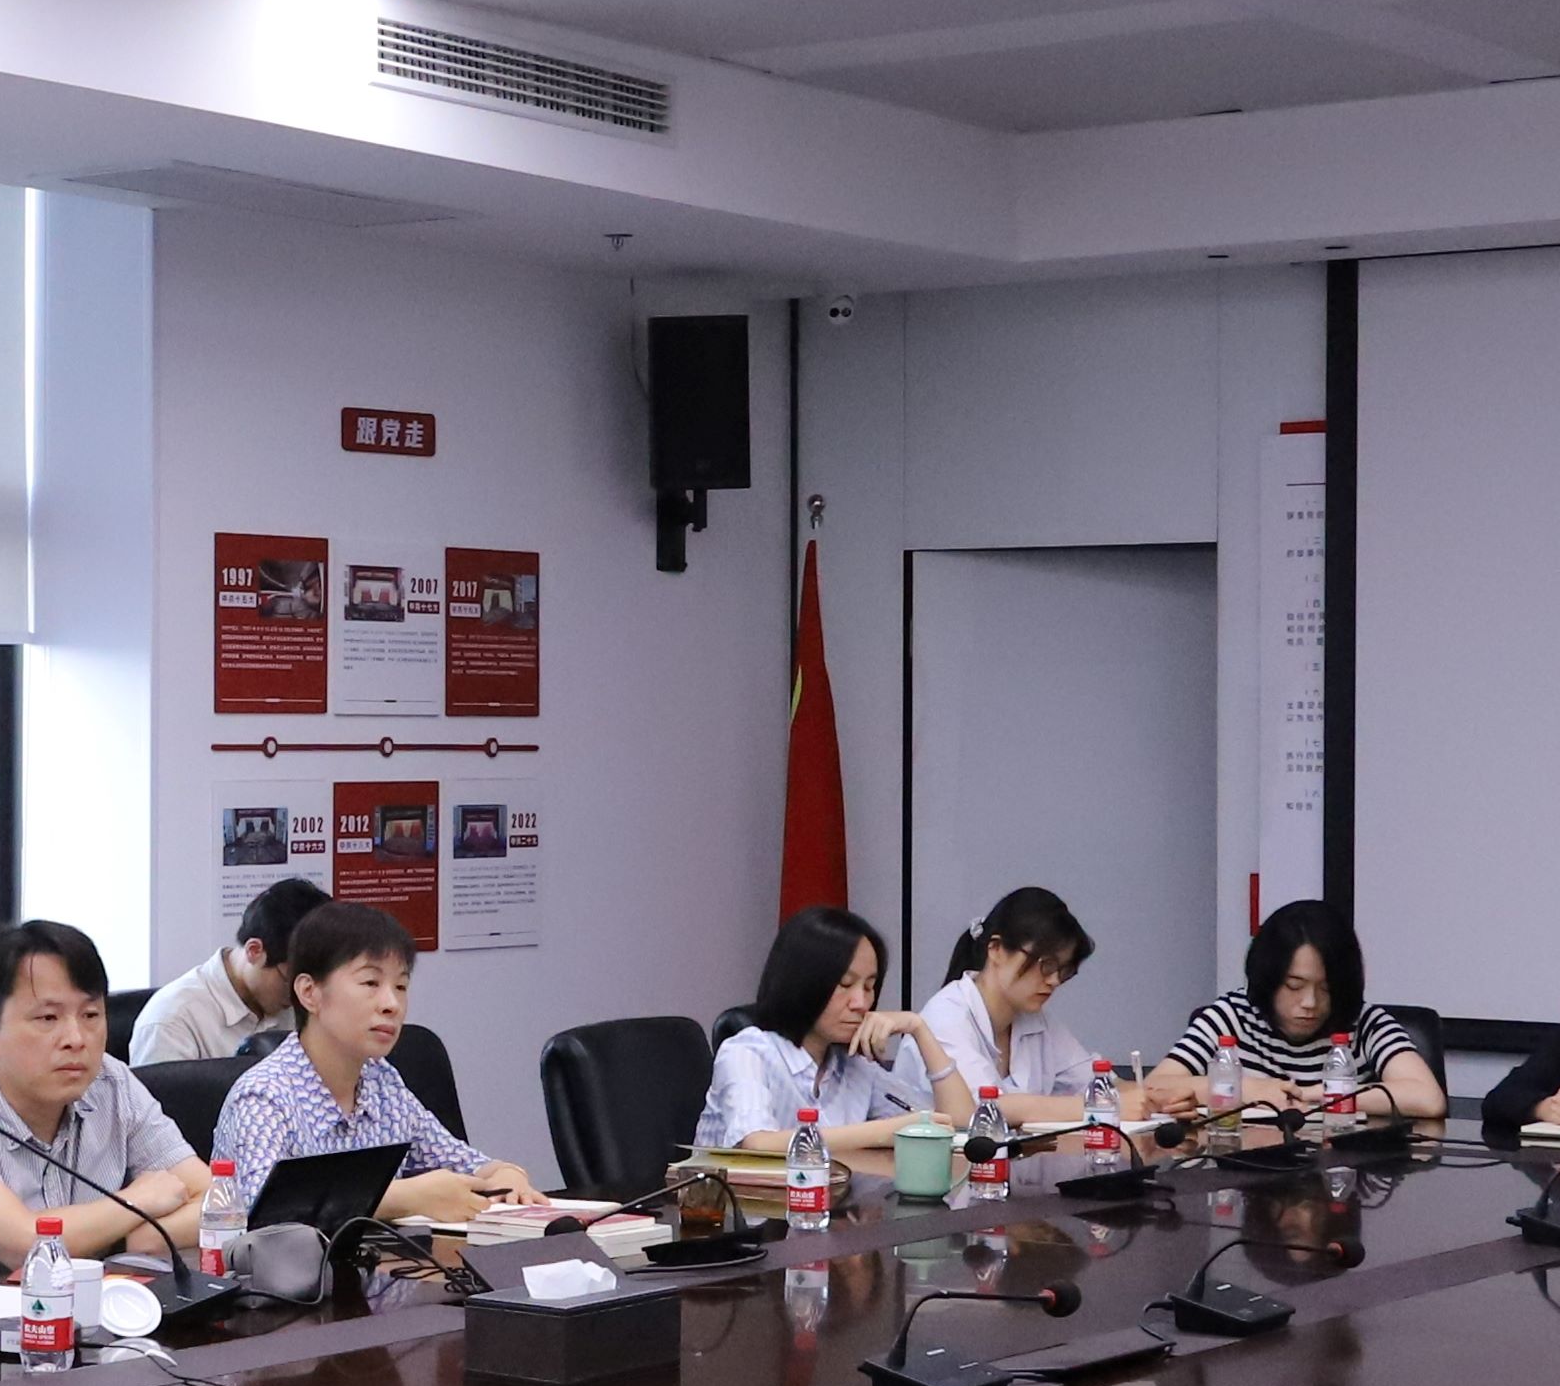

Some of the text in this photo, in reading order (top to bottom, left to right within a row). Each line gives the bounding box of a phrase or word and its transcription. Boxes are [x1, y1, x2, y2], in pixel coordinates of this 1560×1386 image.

[355, 416, 426, 450] 跟党走
[222, 568, 253, 586] 1997
[410, 578, 438, 594] 2007
[452, 581, 477, 597] 2017
[293, 817, 323, 833] 2002
[340, 815, 369, 832] 2012
[512, 813, 536, 829] 2022
